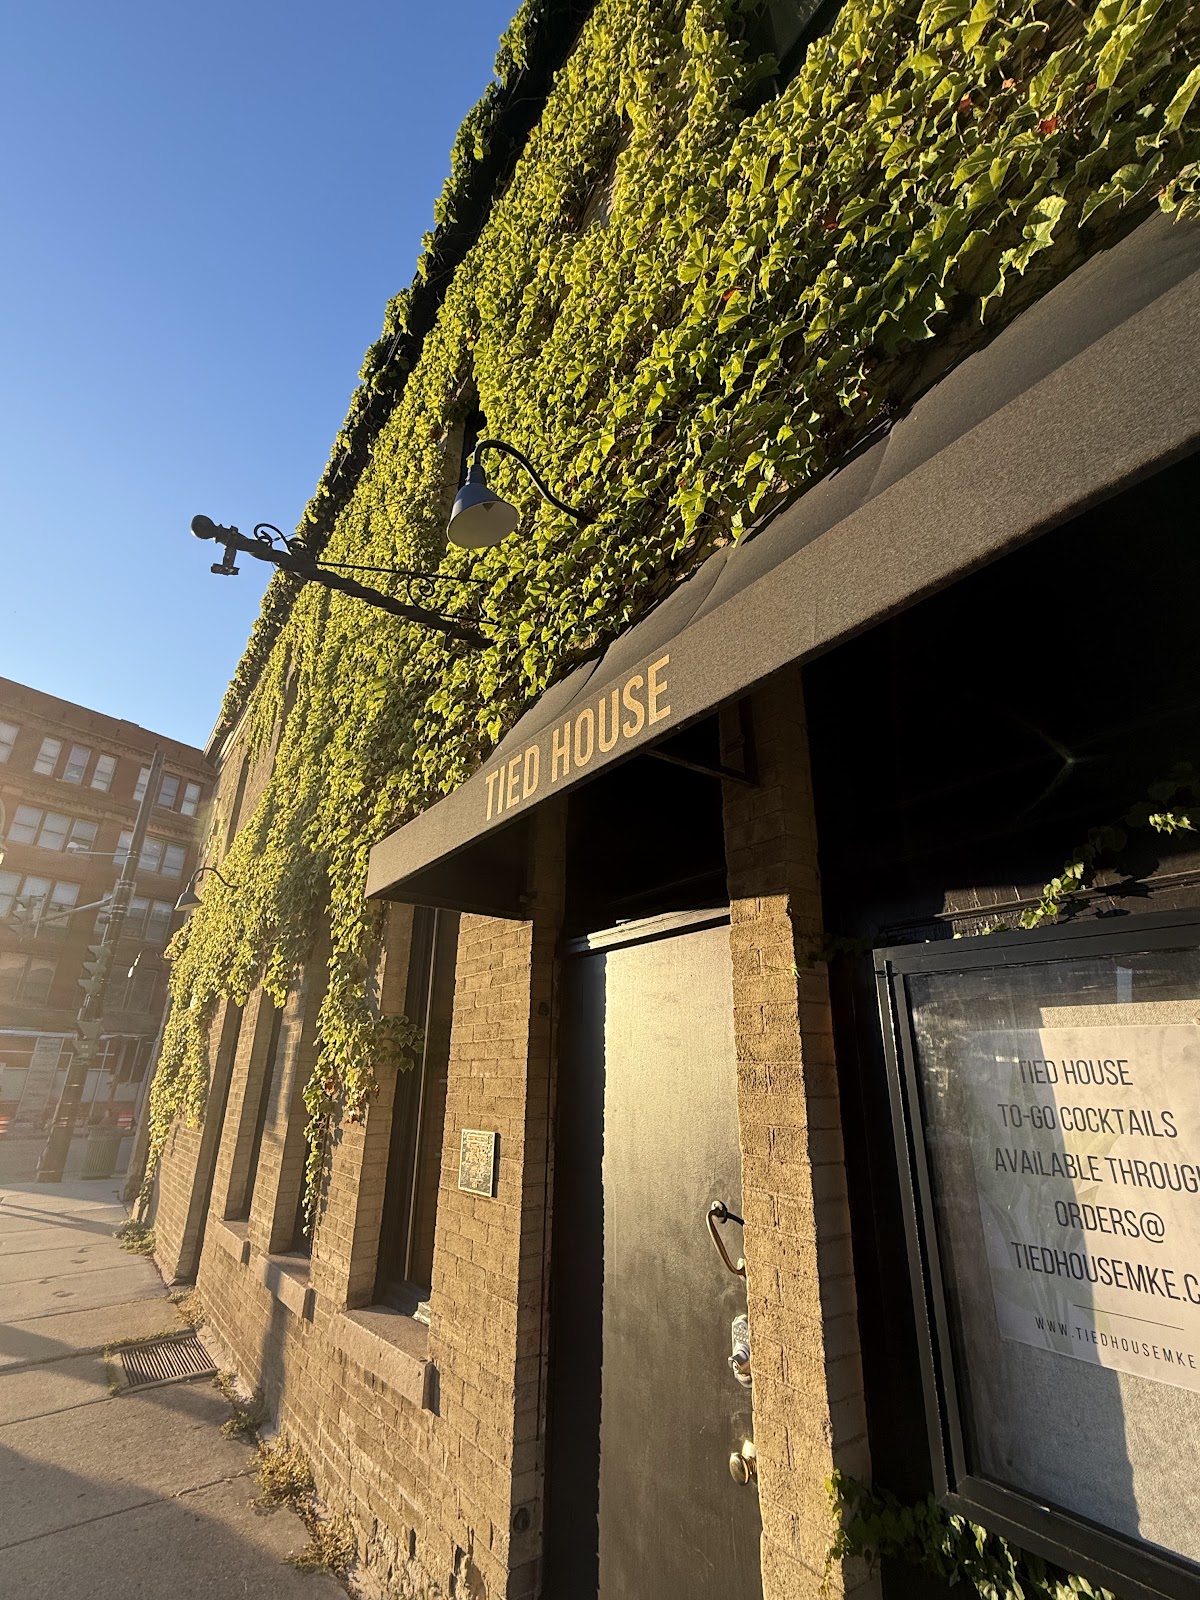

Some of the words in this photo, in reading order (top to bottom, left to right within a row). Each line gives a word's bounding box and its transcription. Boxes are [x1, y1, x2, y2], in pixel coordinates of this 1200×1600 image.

[485, 744, 540, 821] TIED
[551, 654, 671, 783] HOUSE
[1018, 1060, 1058, 1084] TIED
[1062, 1060, 1134, 1086] HOUSE
[997, 1103, 1057, 1130] TO-GO
[1059, 1106, 1178, 1138] COCKTAILS
[995, 1147, 1103, 1182] AVAILABLE
[1055, 1200, 1166, 1243] ORDERS@
